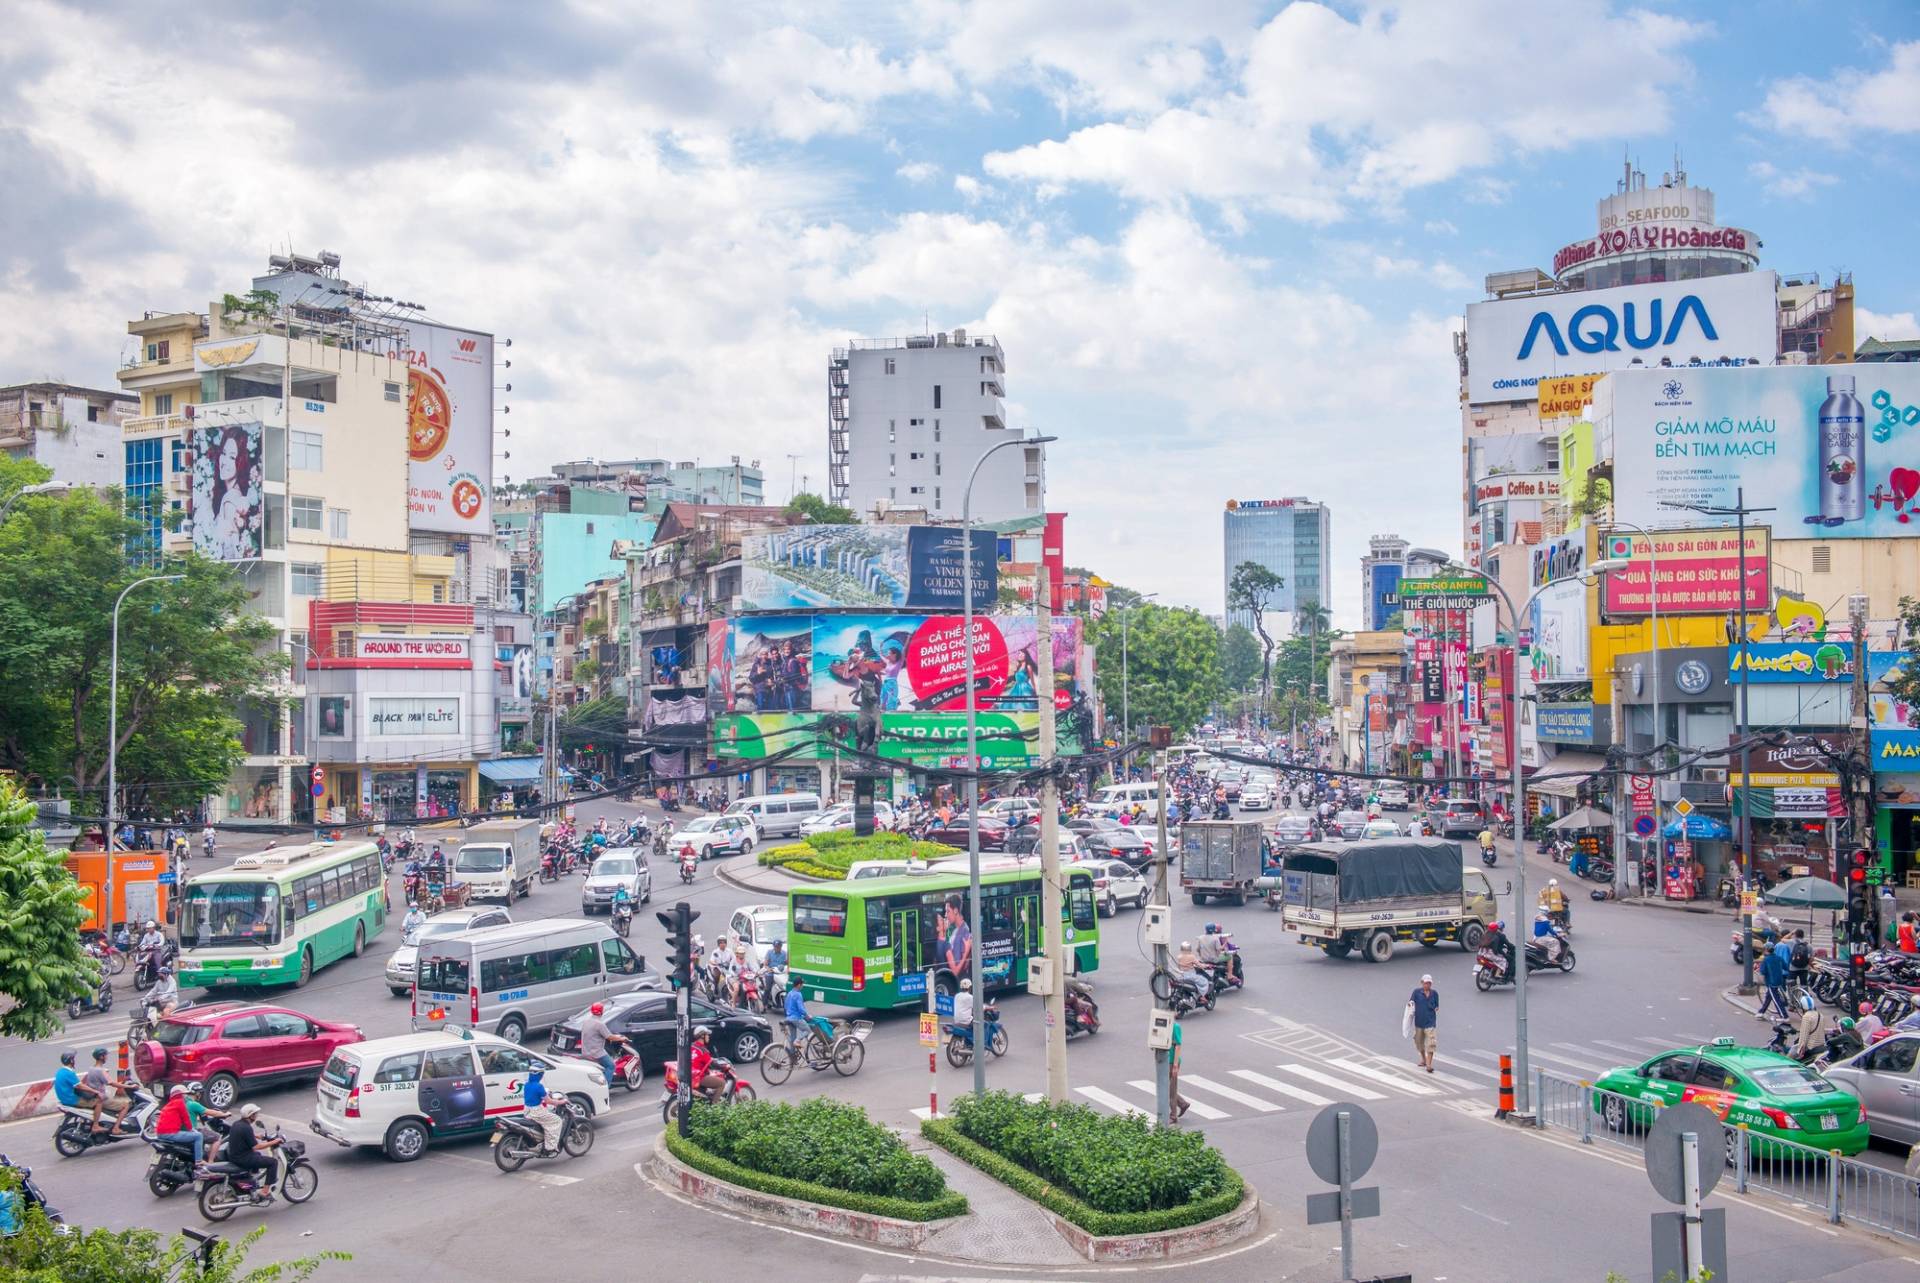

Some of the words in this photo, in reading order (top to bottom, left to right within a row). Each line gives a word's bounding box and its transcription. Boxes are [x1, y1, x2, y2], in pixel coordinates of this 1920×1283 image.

[1627, 206, 1690, 223] SEAFOOD
[1599, 225, 1660, 257] XOAY
[1517, 295, 1719, 360] AQUA
[1493, 378, 1519, 390] CÔNG
[1552, 381, 1568, 395] YẾN
[1655, 416, 1700, 436] GIẢM
[1704, 417, 1734, 434] MỠ
[1738, 415, 1776, 434] MÁU
[1656, 438, 1688, 458] BỀN
[1692, 442, 1720, 457] TIM
[1724, 441, 1776, 460] MẠCH
[1508, 481, 1535, 495] Coffee
[1538, 481, 1544, 495] &
[1240, 498, 1294, 508] VIETBANK
[1633, 540, 1650, 554] YẾN
[1655, 540, 1673, 553] SÀO
[1677, 538, 1694, 552] SÀI
[1697, 538, 1717, 551] GÒN
[935, 566, 981, 578] VINHOES
[1628, 570, 1646, 584] QUÀ
[1676, 570, 1695, 582] CHO
[1699, 567, 1718, 580] SỨC
[1720, 566, 1746, 580] KHỎ
[925, 577, 963, 589] GOLDEN
[970, 580, 989, 590] IVER
[1405, 595, 1424, 609] THẾ
[1448, 595, 1474, 609] NƯỚC
[929, 630, 942, 643] CẢ
[944, 625, 961, 640] THẾ
[364, 643, 402, 654] AROUND
[405, 643, 423, 653] THE
[425, 643, 462, 654] WORLD
[921, 643, 947, 656] ĐANG
[921, 653, 949, 668] KHÁM
[974, 643, 990, 654] VỚI
[940, 659, 976, 675] AIRASA
[1428, 661, 1440, 697] HOTEL
[372, 713, 403, 723] BLACK
[882, 726, 1013, 742] ATRAFOODS
[920, 1021, 932, 1034] 138
[380, 1083, 392, 1091] 51F
